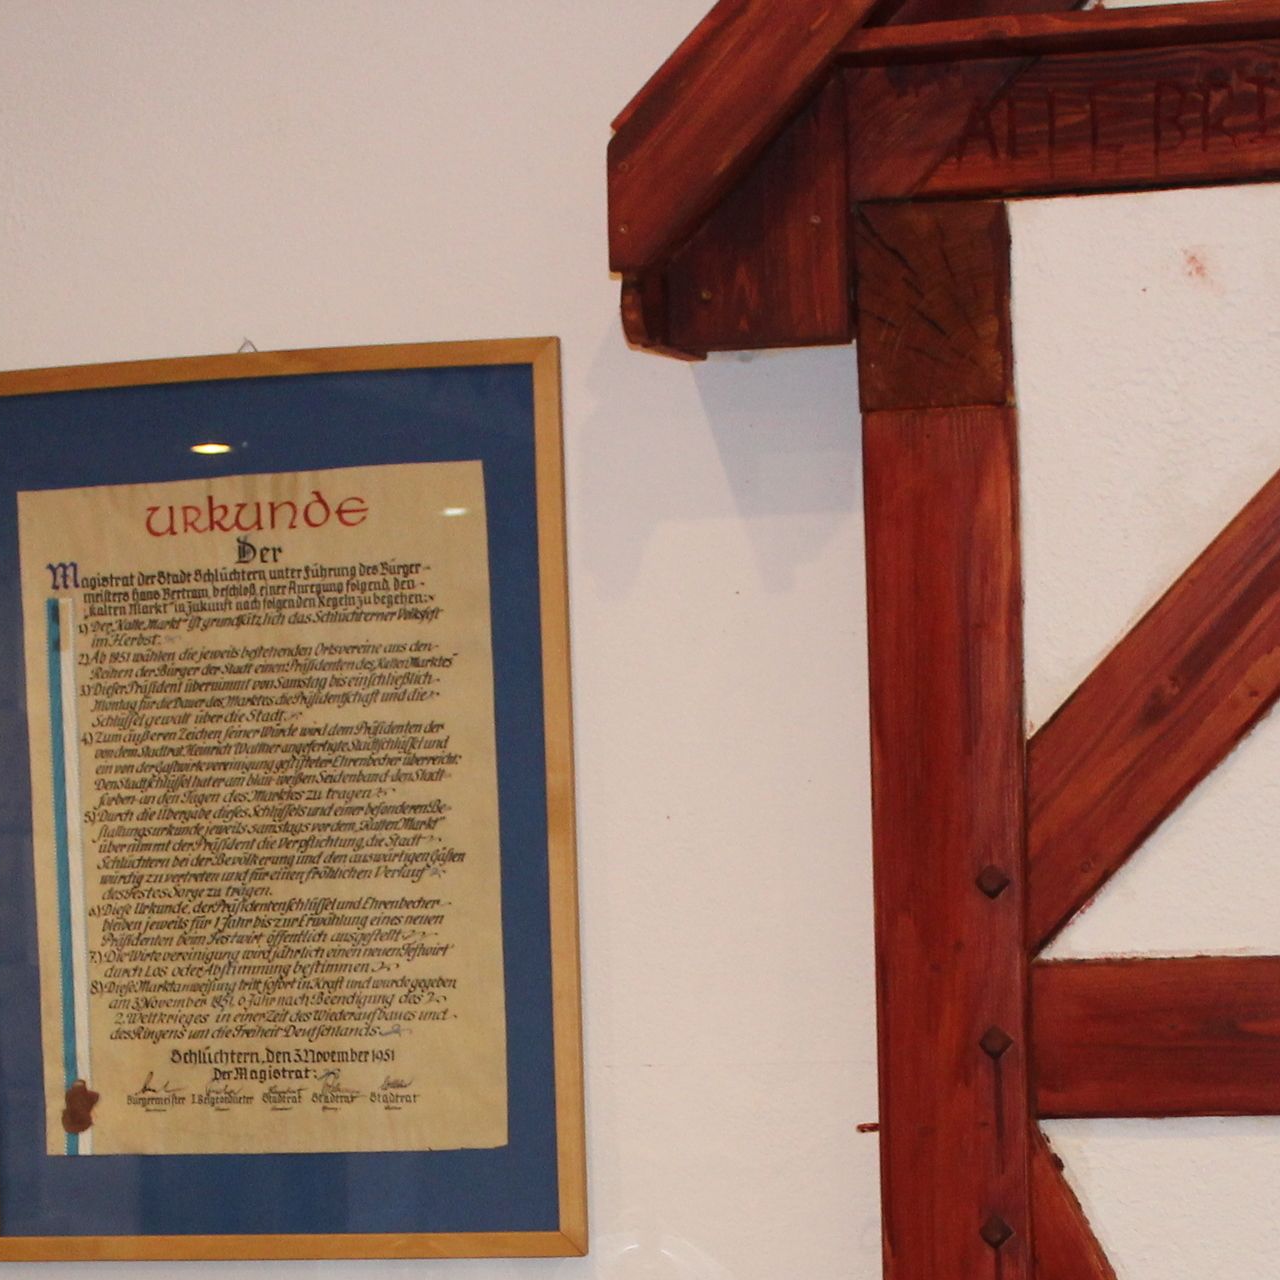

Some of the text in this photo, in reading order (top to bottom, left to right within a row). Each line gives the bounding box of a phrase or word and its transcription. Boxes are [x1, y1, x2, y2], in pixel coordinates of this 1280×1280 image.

[235, 534, 283, 565] Der
[46, 561, 135, 592] Magistrat
[137, 572, 156, 585] der
[156, 570, 191, 584] Stadt
[268, 565, 302, 579] unter
[358, 562, 378, 575] des
[393, 576, 415, 589] den
[371, 1047, 395, 1061] 1951
